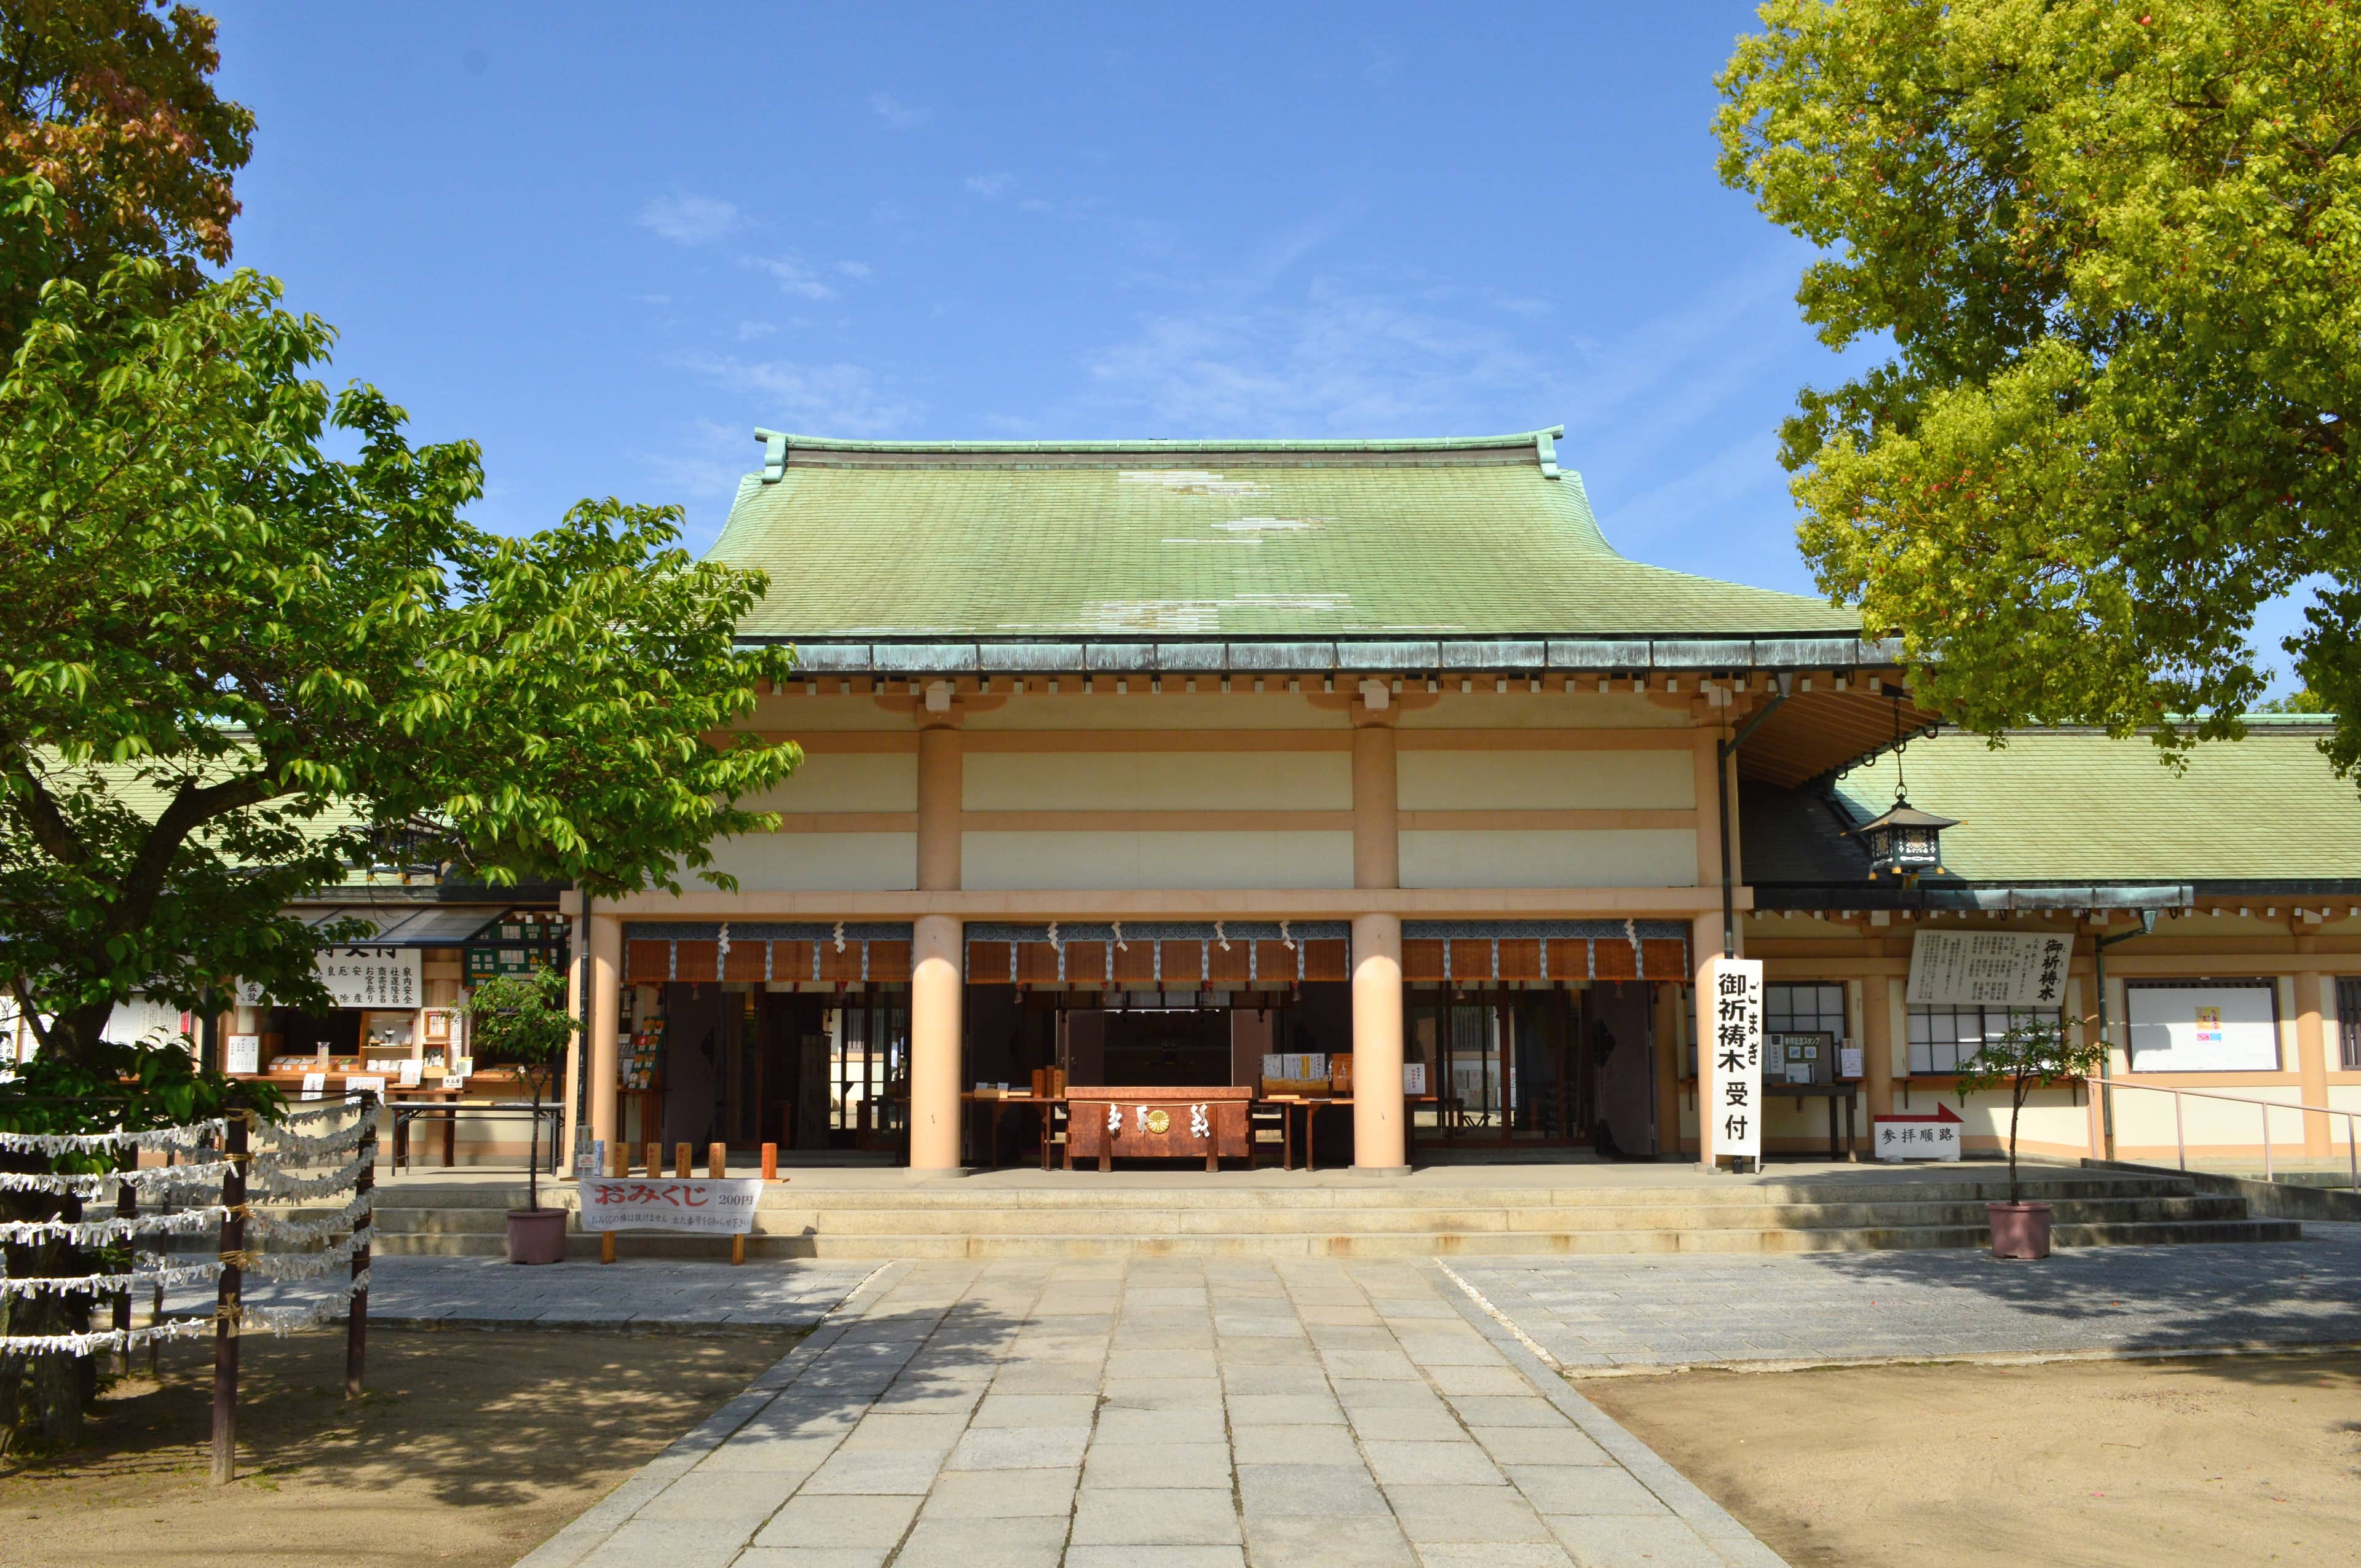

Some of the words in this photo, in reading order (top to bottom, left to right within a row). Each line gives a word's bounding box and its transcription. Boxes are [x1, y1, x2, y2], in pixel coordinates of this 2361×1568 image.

[365, 967, 376, 1003] お宮参り
[378, 967, 387, 1003] 商売繁昌
[390, 967, 400, 1004] 社運隆昌
[403, 967, 414, 1004] 家内安全
[2036, 939, 2063, 1001] 御祈祷木
[1718, 973, 1747, 1073] 御祈祷木
[1749, 981, 1759, 1065] ごまぎ
[1725, 1082, 1748, 1140] 受付
[1882, 1127, 1955, 1144] 参拝順路
[594, 1184, 709, 1207] おみくじ
[719, 1194, 753, 1205] 200円
